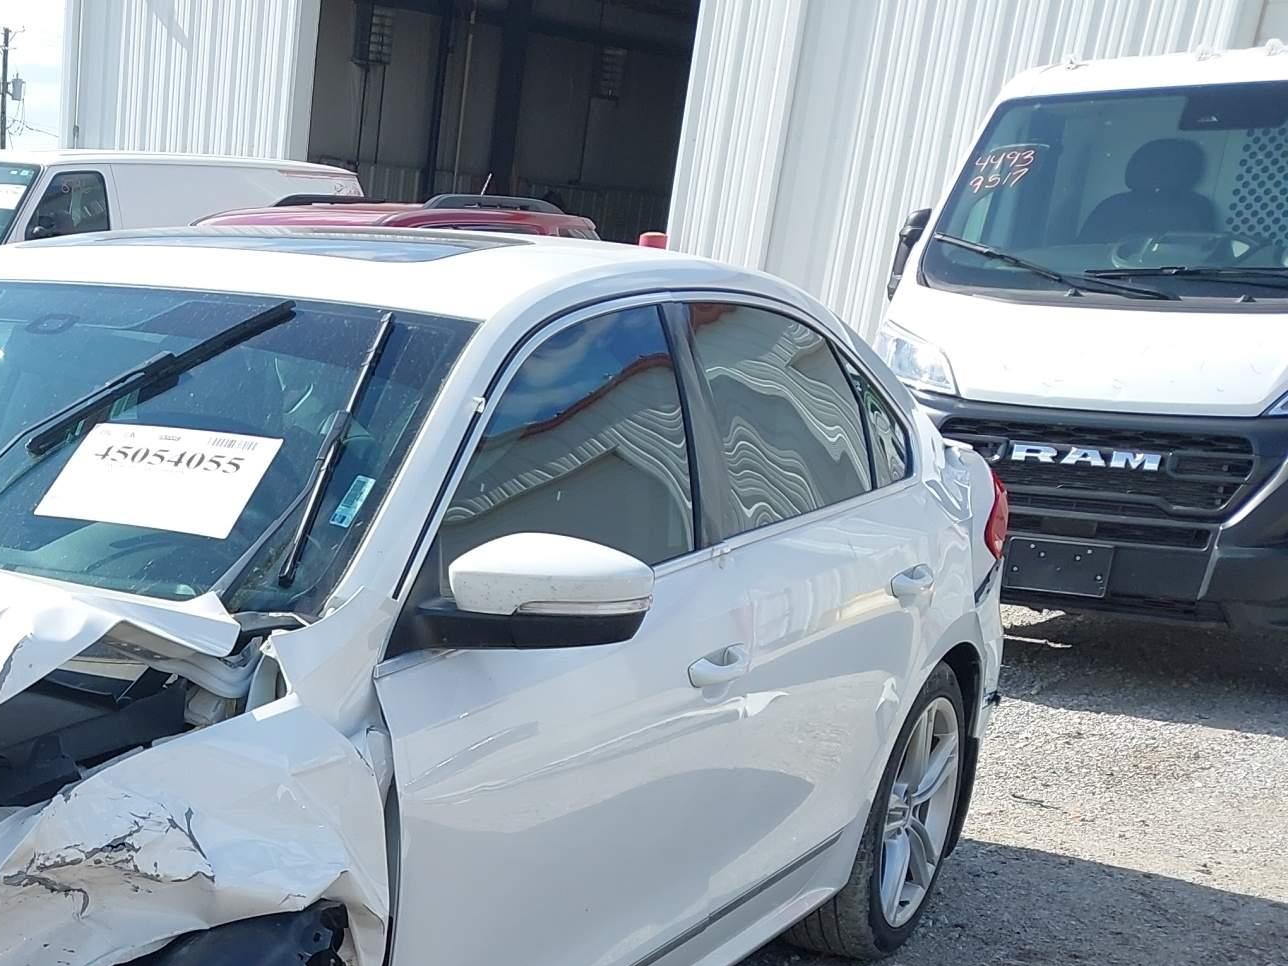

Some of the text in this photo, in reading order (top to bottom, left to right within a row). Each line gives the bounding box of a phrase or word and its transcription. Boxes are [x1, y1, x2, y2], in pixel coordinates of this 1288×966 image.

[975, 150, 1035, 172] 4493
[969, 167, 1029, 193] 9517
[94, 444, 246, 475] 45054055
[1011, 443, 1162, 472] RAM
